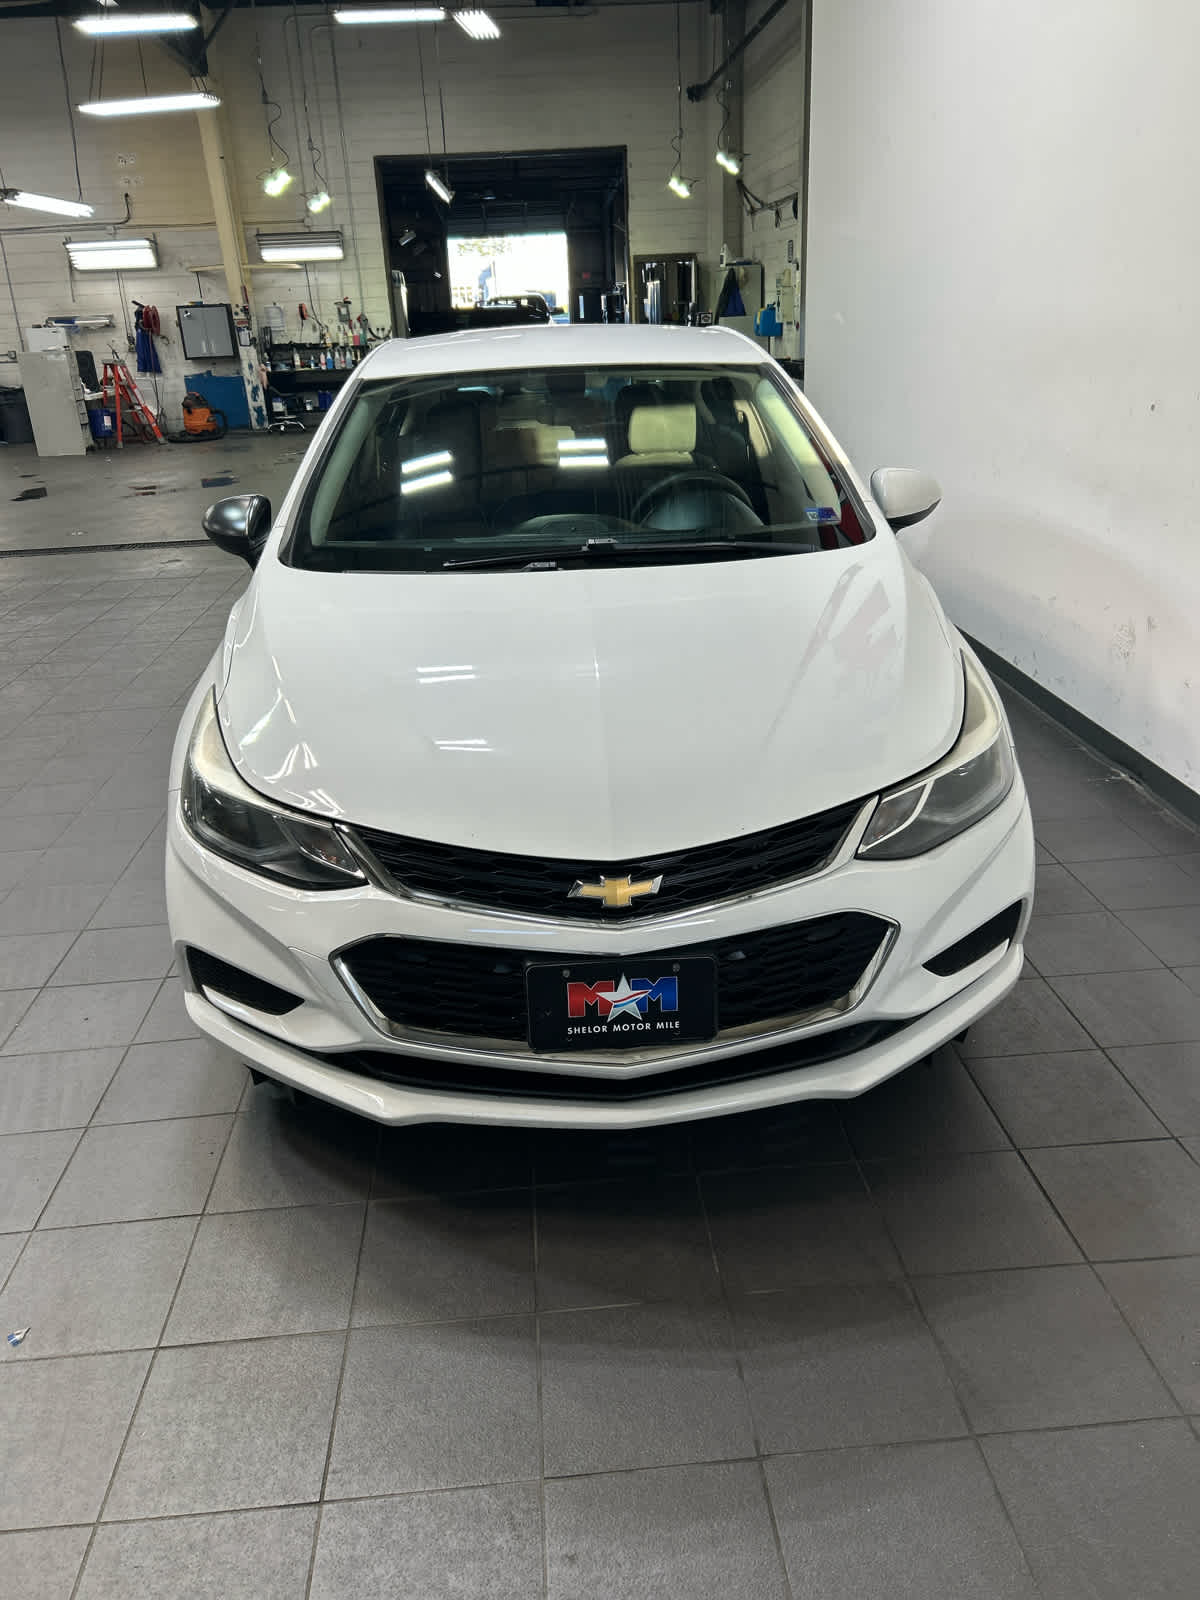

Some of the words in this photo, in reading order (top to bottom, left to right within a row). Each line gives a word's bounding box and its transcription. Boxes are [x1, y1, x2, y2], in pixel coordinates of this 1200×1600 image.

[567, 1025, 608, 1035] SHELOR
[612, 1022, 651, 1032] MOTOR
[656, 1021, 680, 1030] MILE
